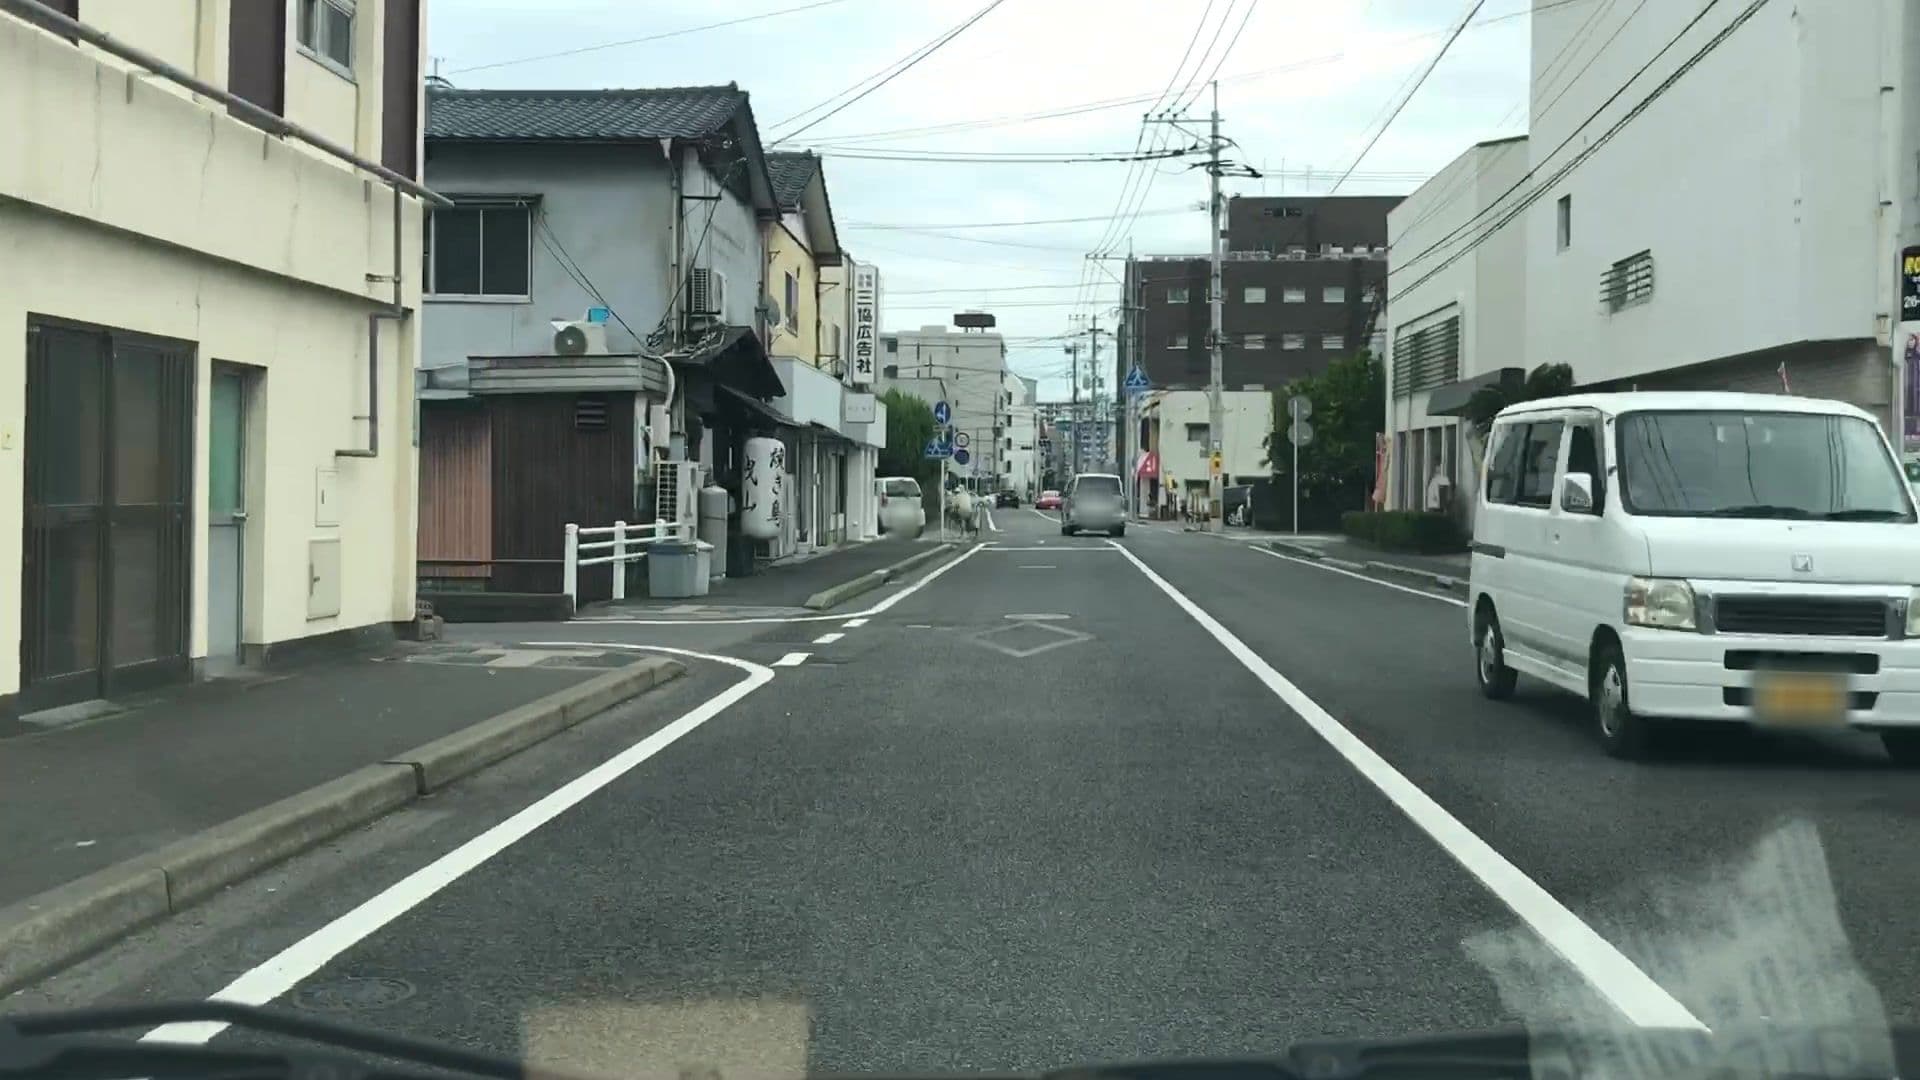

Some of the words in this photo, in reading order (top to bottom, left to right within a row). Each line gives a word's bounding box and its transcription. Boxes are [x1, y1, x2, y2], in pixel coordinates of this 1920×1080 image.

[856, 291, 873, 373] 三協広告社
